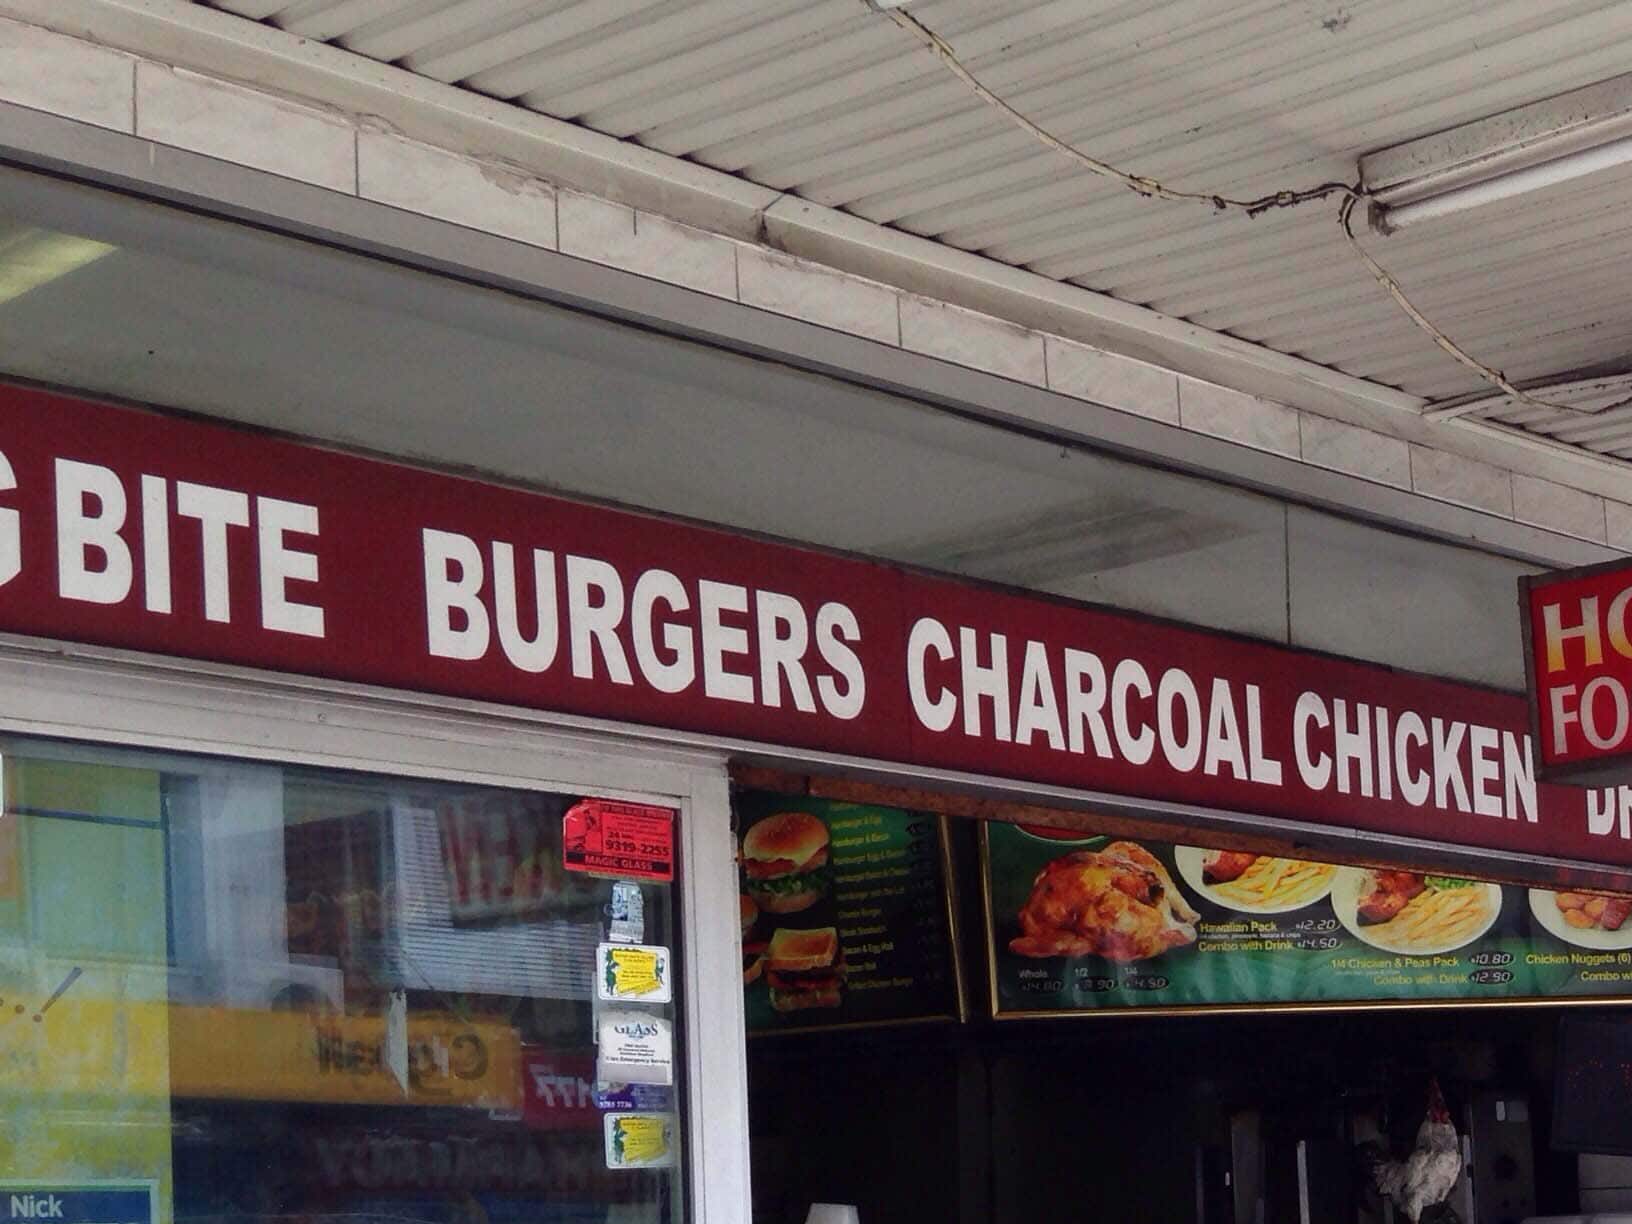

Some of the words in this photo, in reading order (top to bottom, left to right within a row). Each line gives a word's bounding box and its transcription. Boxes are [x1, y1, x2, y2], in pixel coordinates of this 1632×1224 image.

[55, 457, 326, 639] BITE
[422, 528, 866, 720] BURGERS
[907, 617, 1283, 786] CHARCOAL
[1294, 690, 1539, 823] CHICKEN
[621, 858, 653, 871] GLASS
[1199, 922, 1249, 933] Hawaiian
[1251, 920, 1277, 932] Pack
[1198, 940, 1238, 951] Combo
[1241, 940, 1263, 951] with
[1265, 939, 1293, 950] Drink
[1349, 959, 1392, 969] Chicken
[1394, 958, 1403, 968] &
[1405, 957, 1430, 968] Peas
[1433, 956, 1459, 967] Pack
[1526, 953, 1569, 964] Chicken
[1571, 952, 1616, 966] Nuggets
[1374, 975, 1411, 985] Combo
[1415, 975, 1434, 985] with
[1439, 974, 1468, 985] Drink
[1580, 971, 1620, 982] Combo
[10, 1193, 64, 1218] Nick
